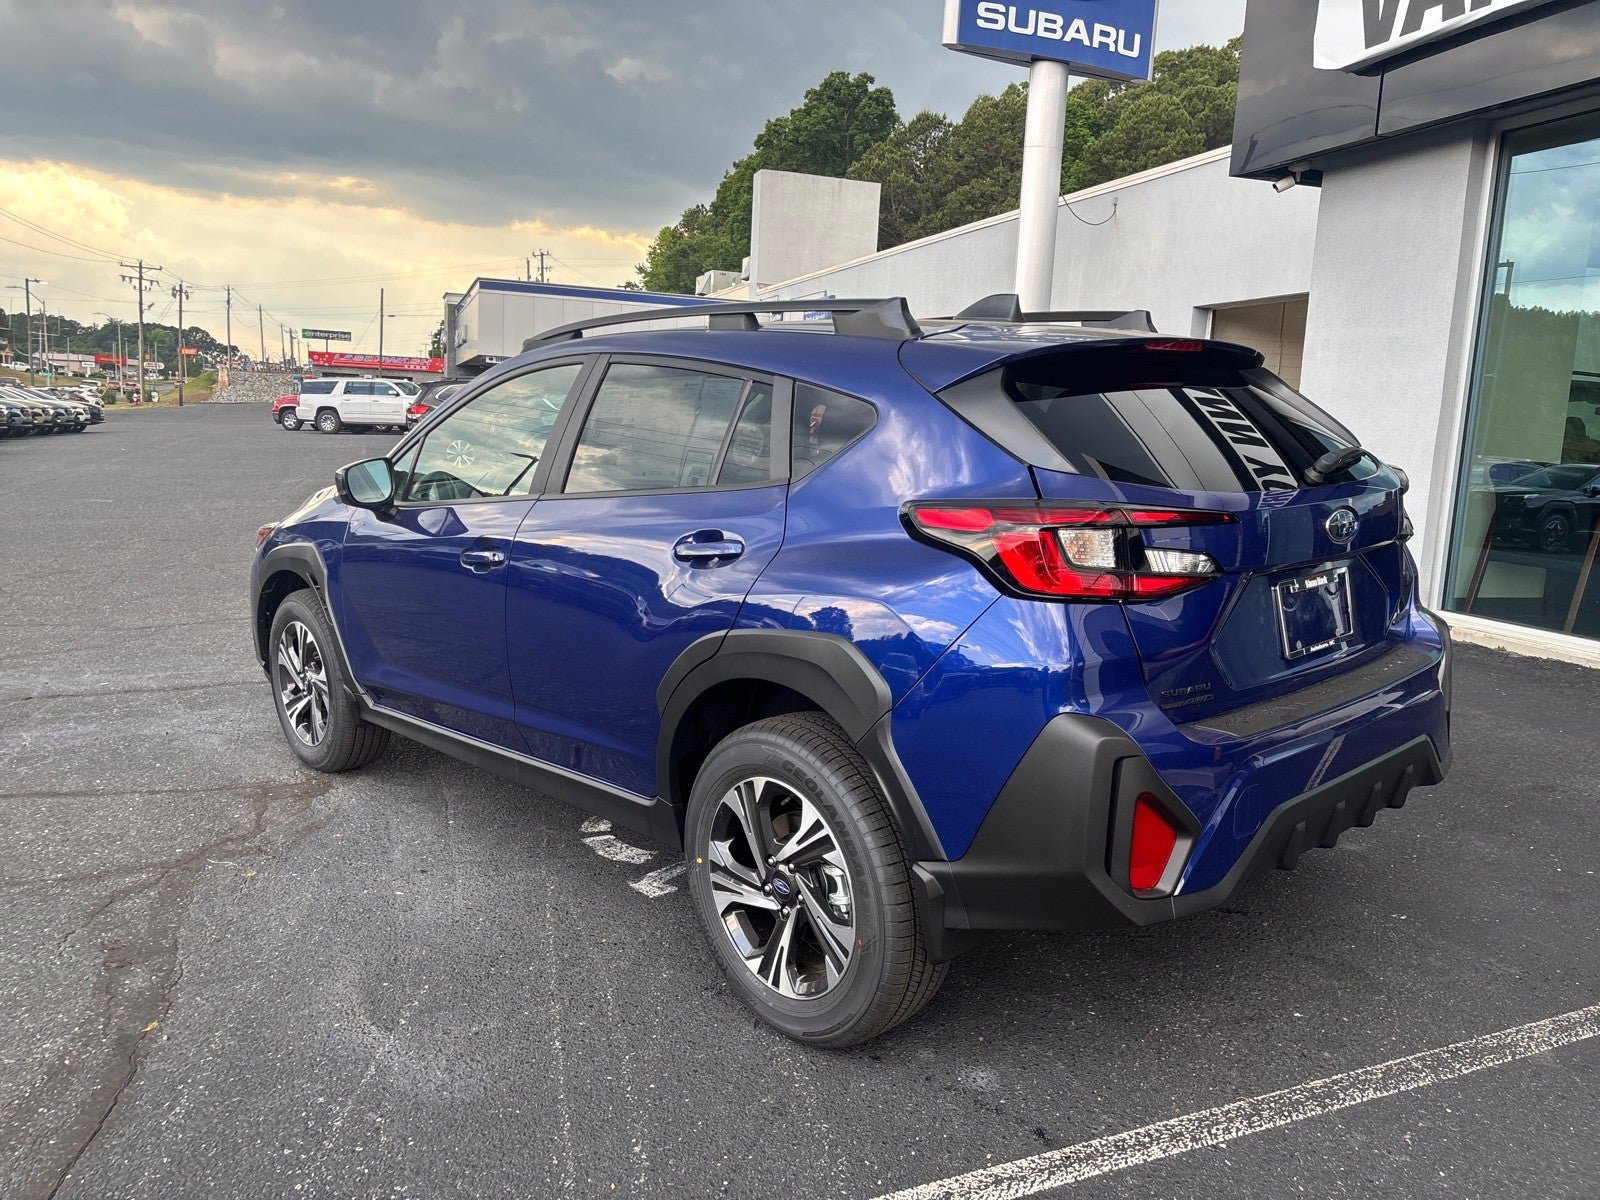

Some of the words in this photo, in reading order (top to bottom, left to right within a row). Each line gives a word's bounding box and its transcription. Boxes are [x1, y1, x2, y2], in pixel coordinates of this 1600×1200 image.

[976, 1, 1141, 58] SUBARU
[303, 330, 351, 340] enterprise
[1160, 682, 1212, 698] SUBARU
